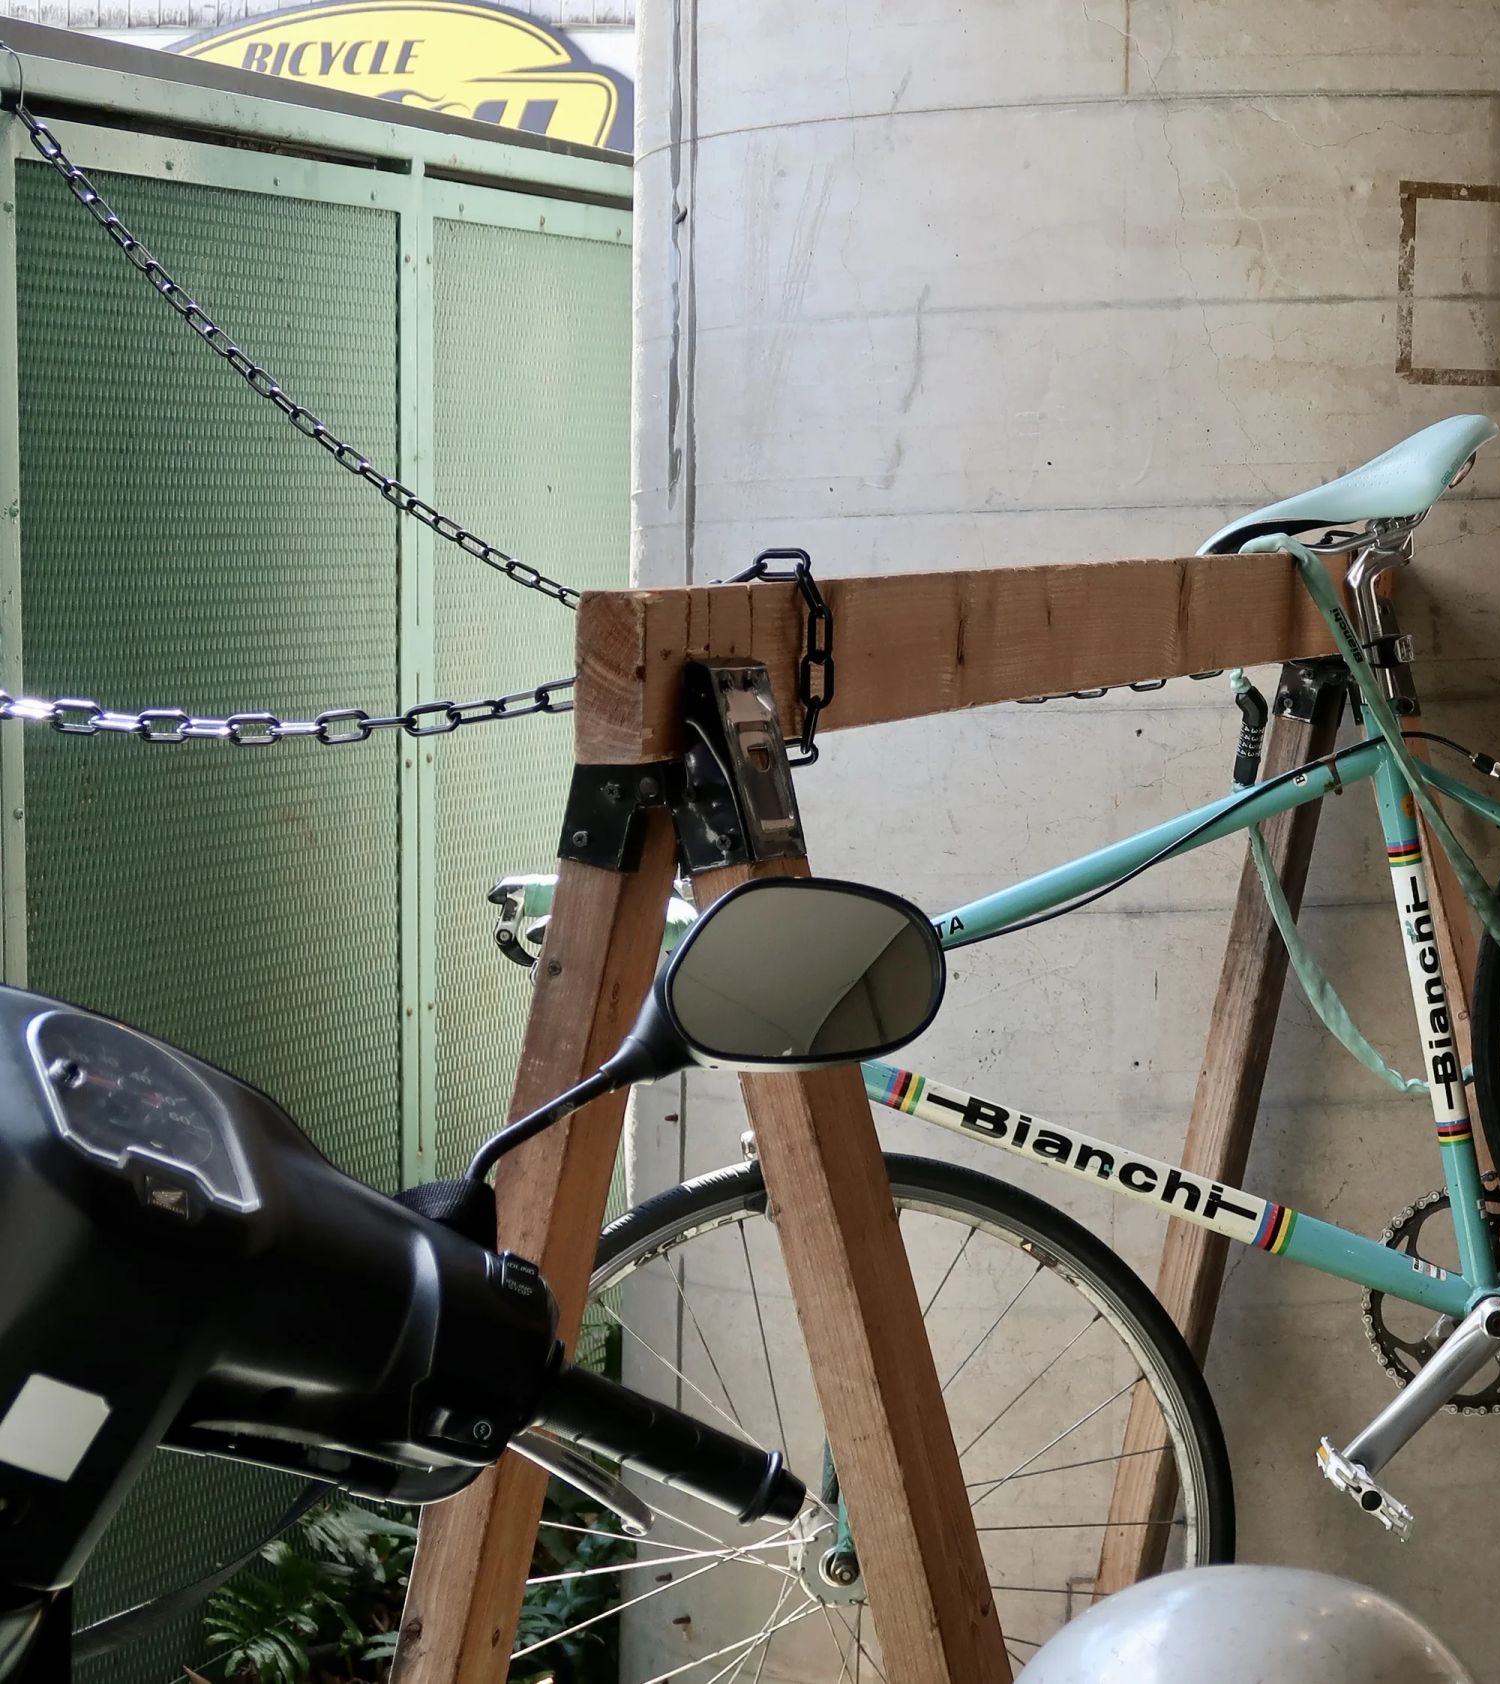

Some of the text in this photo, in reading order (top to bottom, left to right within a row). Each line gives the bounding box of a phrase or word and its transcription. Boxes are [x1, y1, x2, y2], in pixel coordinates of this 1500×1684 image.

[241, 39, 425, 76] BICYCLE
[1329, 607, 1363, 663] Bianchi
[1406, 880, 1458, 1105] Bianchi
[926, 1092, 1257, 1220] Bianchi
